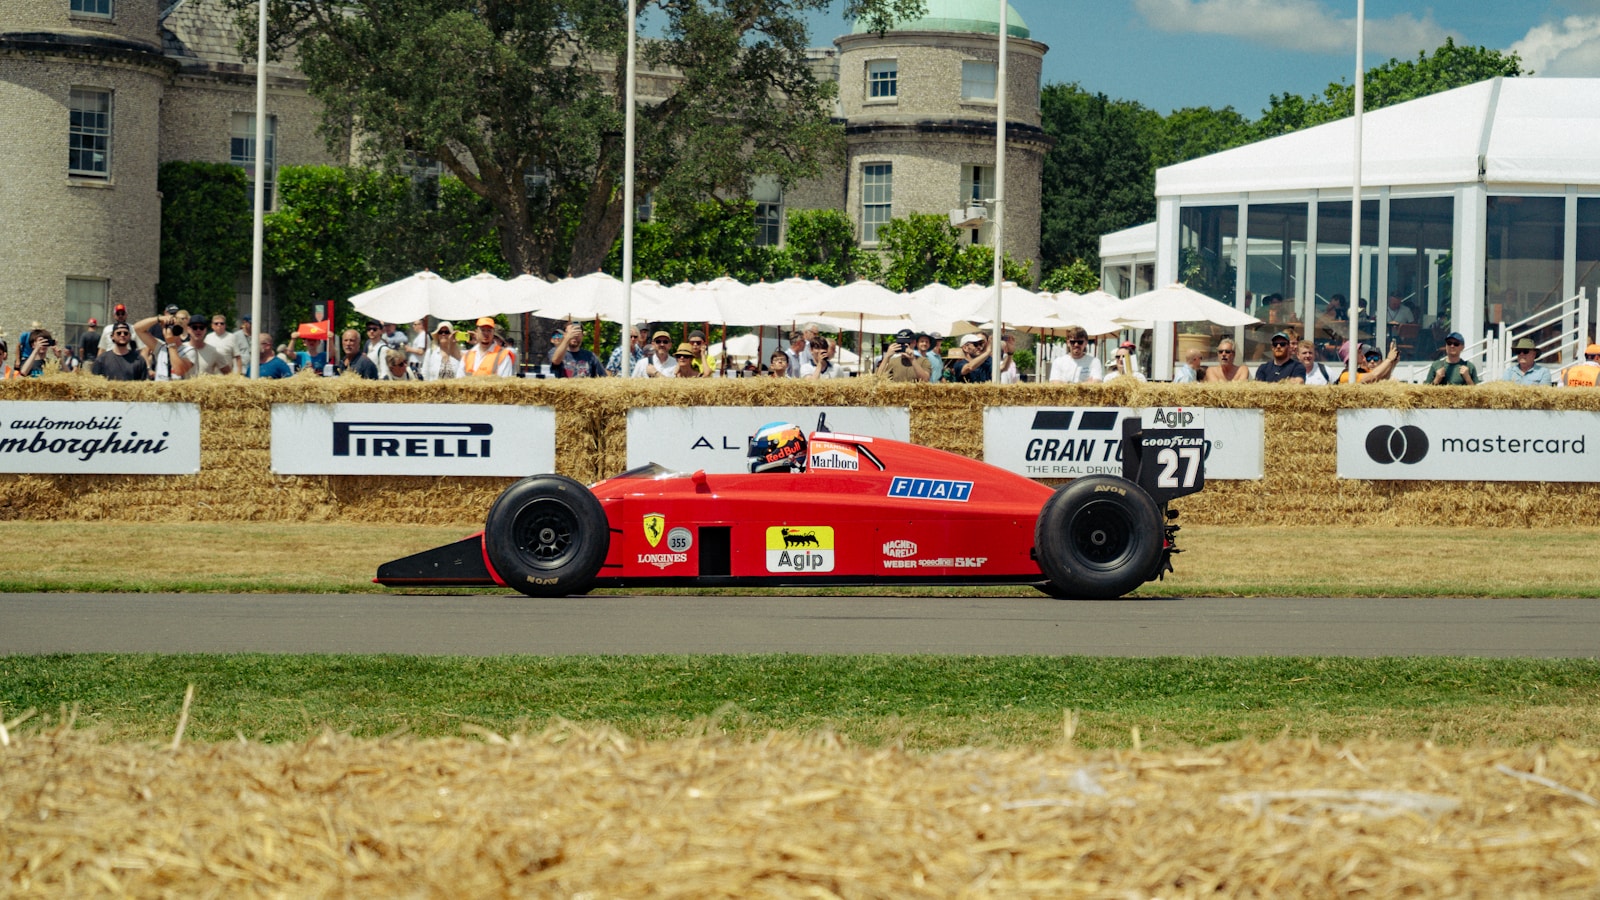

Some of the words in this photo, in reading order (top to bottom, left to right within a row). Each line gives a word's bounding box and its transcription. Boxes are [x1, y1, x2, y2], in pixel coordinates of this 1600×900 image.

[10, 416, 122, 430] automobili
[1153, 408, 1194, 428] Agip
[0, 431, 169, 461] mborghini
[333, 422, 493, 457] PIRELLI
[1142, 436, 1203, 447] GOODYEAR
[1442, 435, 1585, 454] mastercard
[766, 448, 785, 463] Red
[784, 441, 801, 456] Bull
[1025, 438, 1096, 462] GRAN
[812, 454, 858, 469] Marlboro
[1026, 465, 1049, 474] THE
[1052, 465, 1083, 474] REAL
[1086, 466, 1123, 474] DRIVIN
[1157, 448, 1200, 488] 27
[894, 480, 968, 498] FIAT
[1094, 485, 1127, 497] AVON
[671, 538, 686, 548] 355
[637, 553, 688, 563] LONGINES
[778, 550, 824, 571] Agip
[883, 560, 917, 568] WEBER
[954, 557, 988, 568] SKF
[526, 575, 559, 585] AVON
